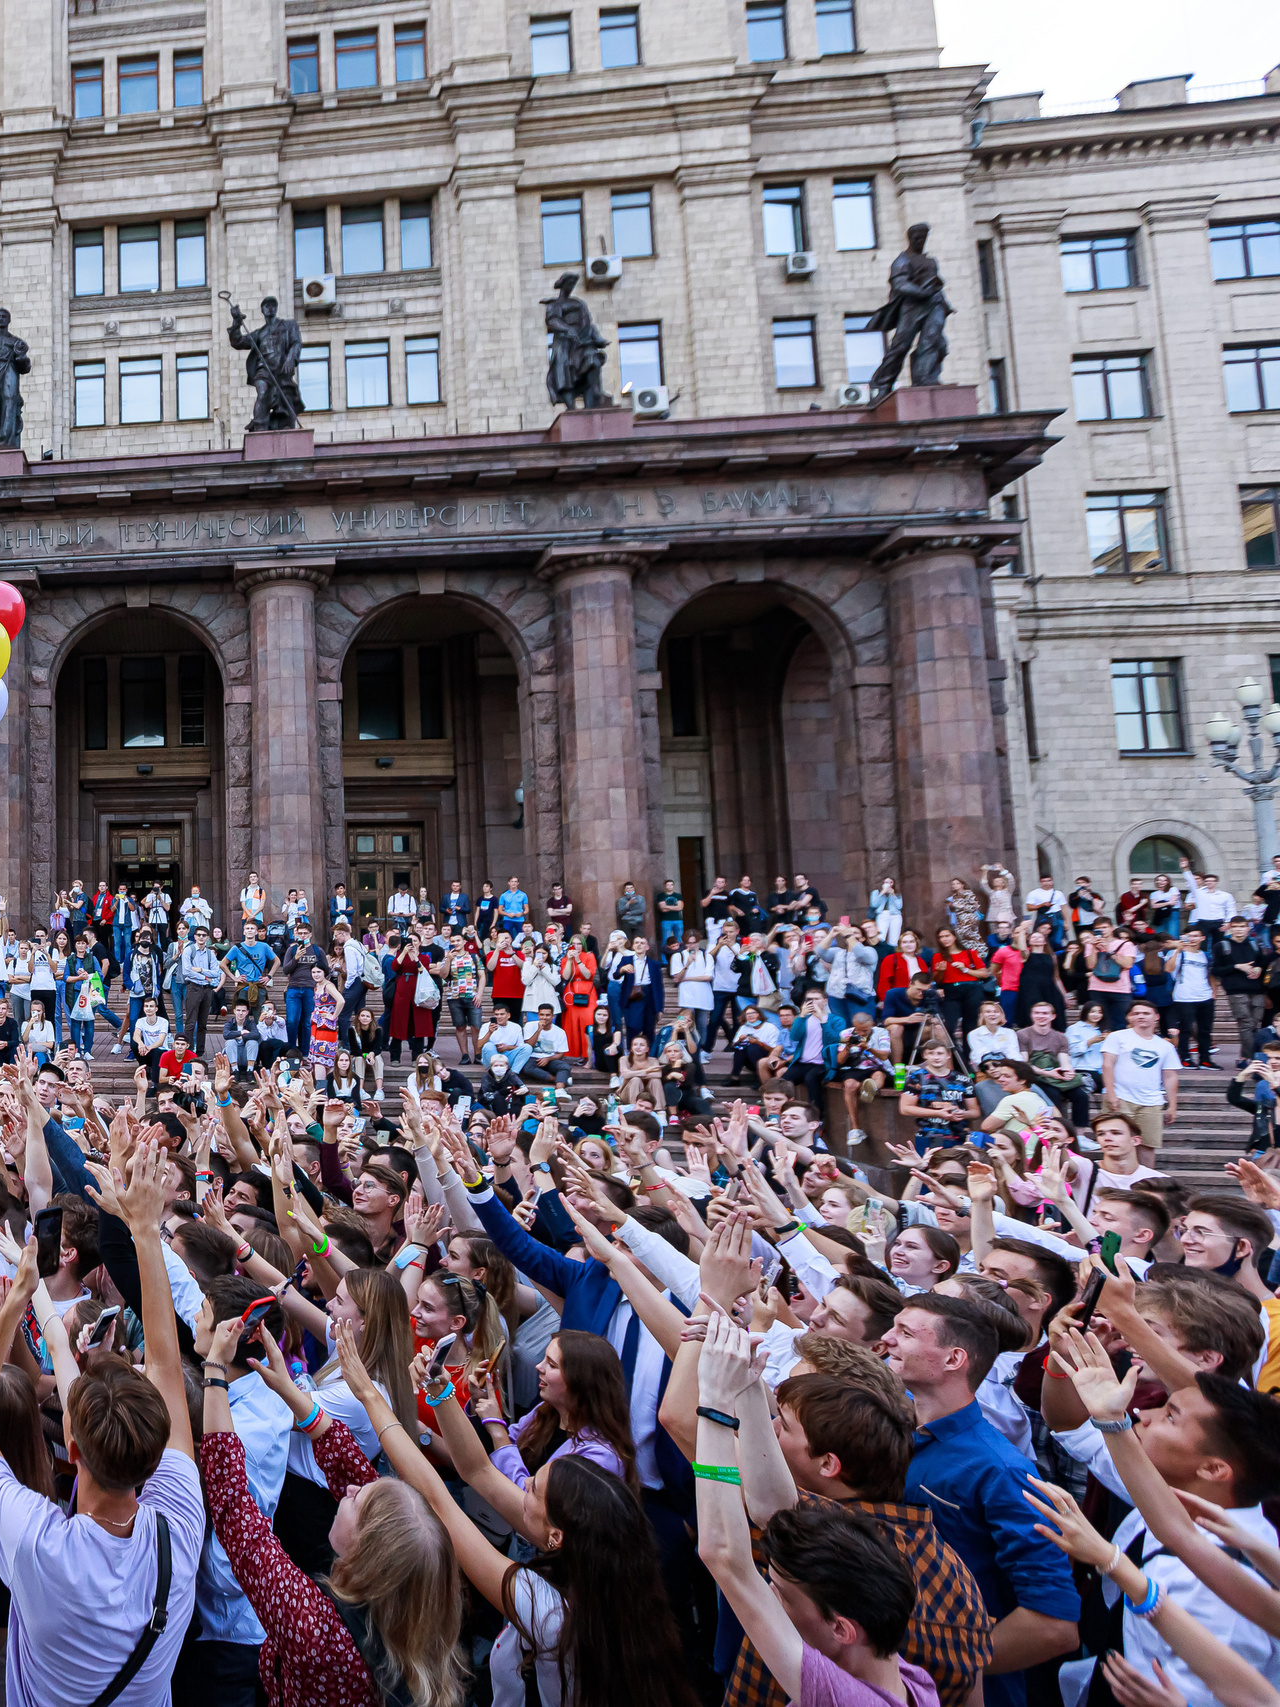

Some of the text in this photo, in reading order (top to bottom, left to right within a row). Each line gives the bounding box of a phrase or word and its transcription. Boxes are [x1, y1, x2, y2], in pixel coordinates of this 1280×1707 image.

[119, 510, 305, 543] ТЕХНИЧЕСКИЙ
[332, 501, 530, 531] УНИВЕРСИТЕТ
[702, 485, 835, 515] БАУМАНА
